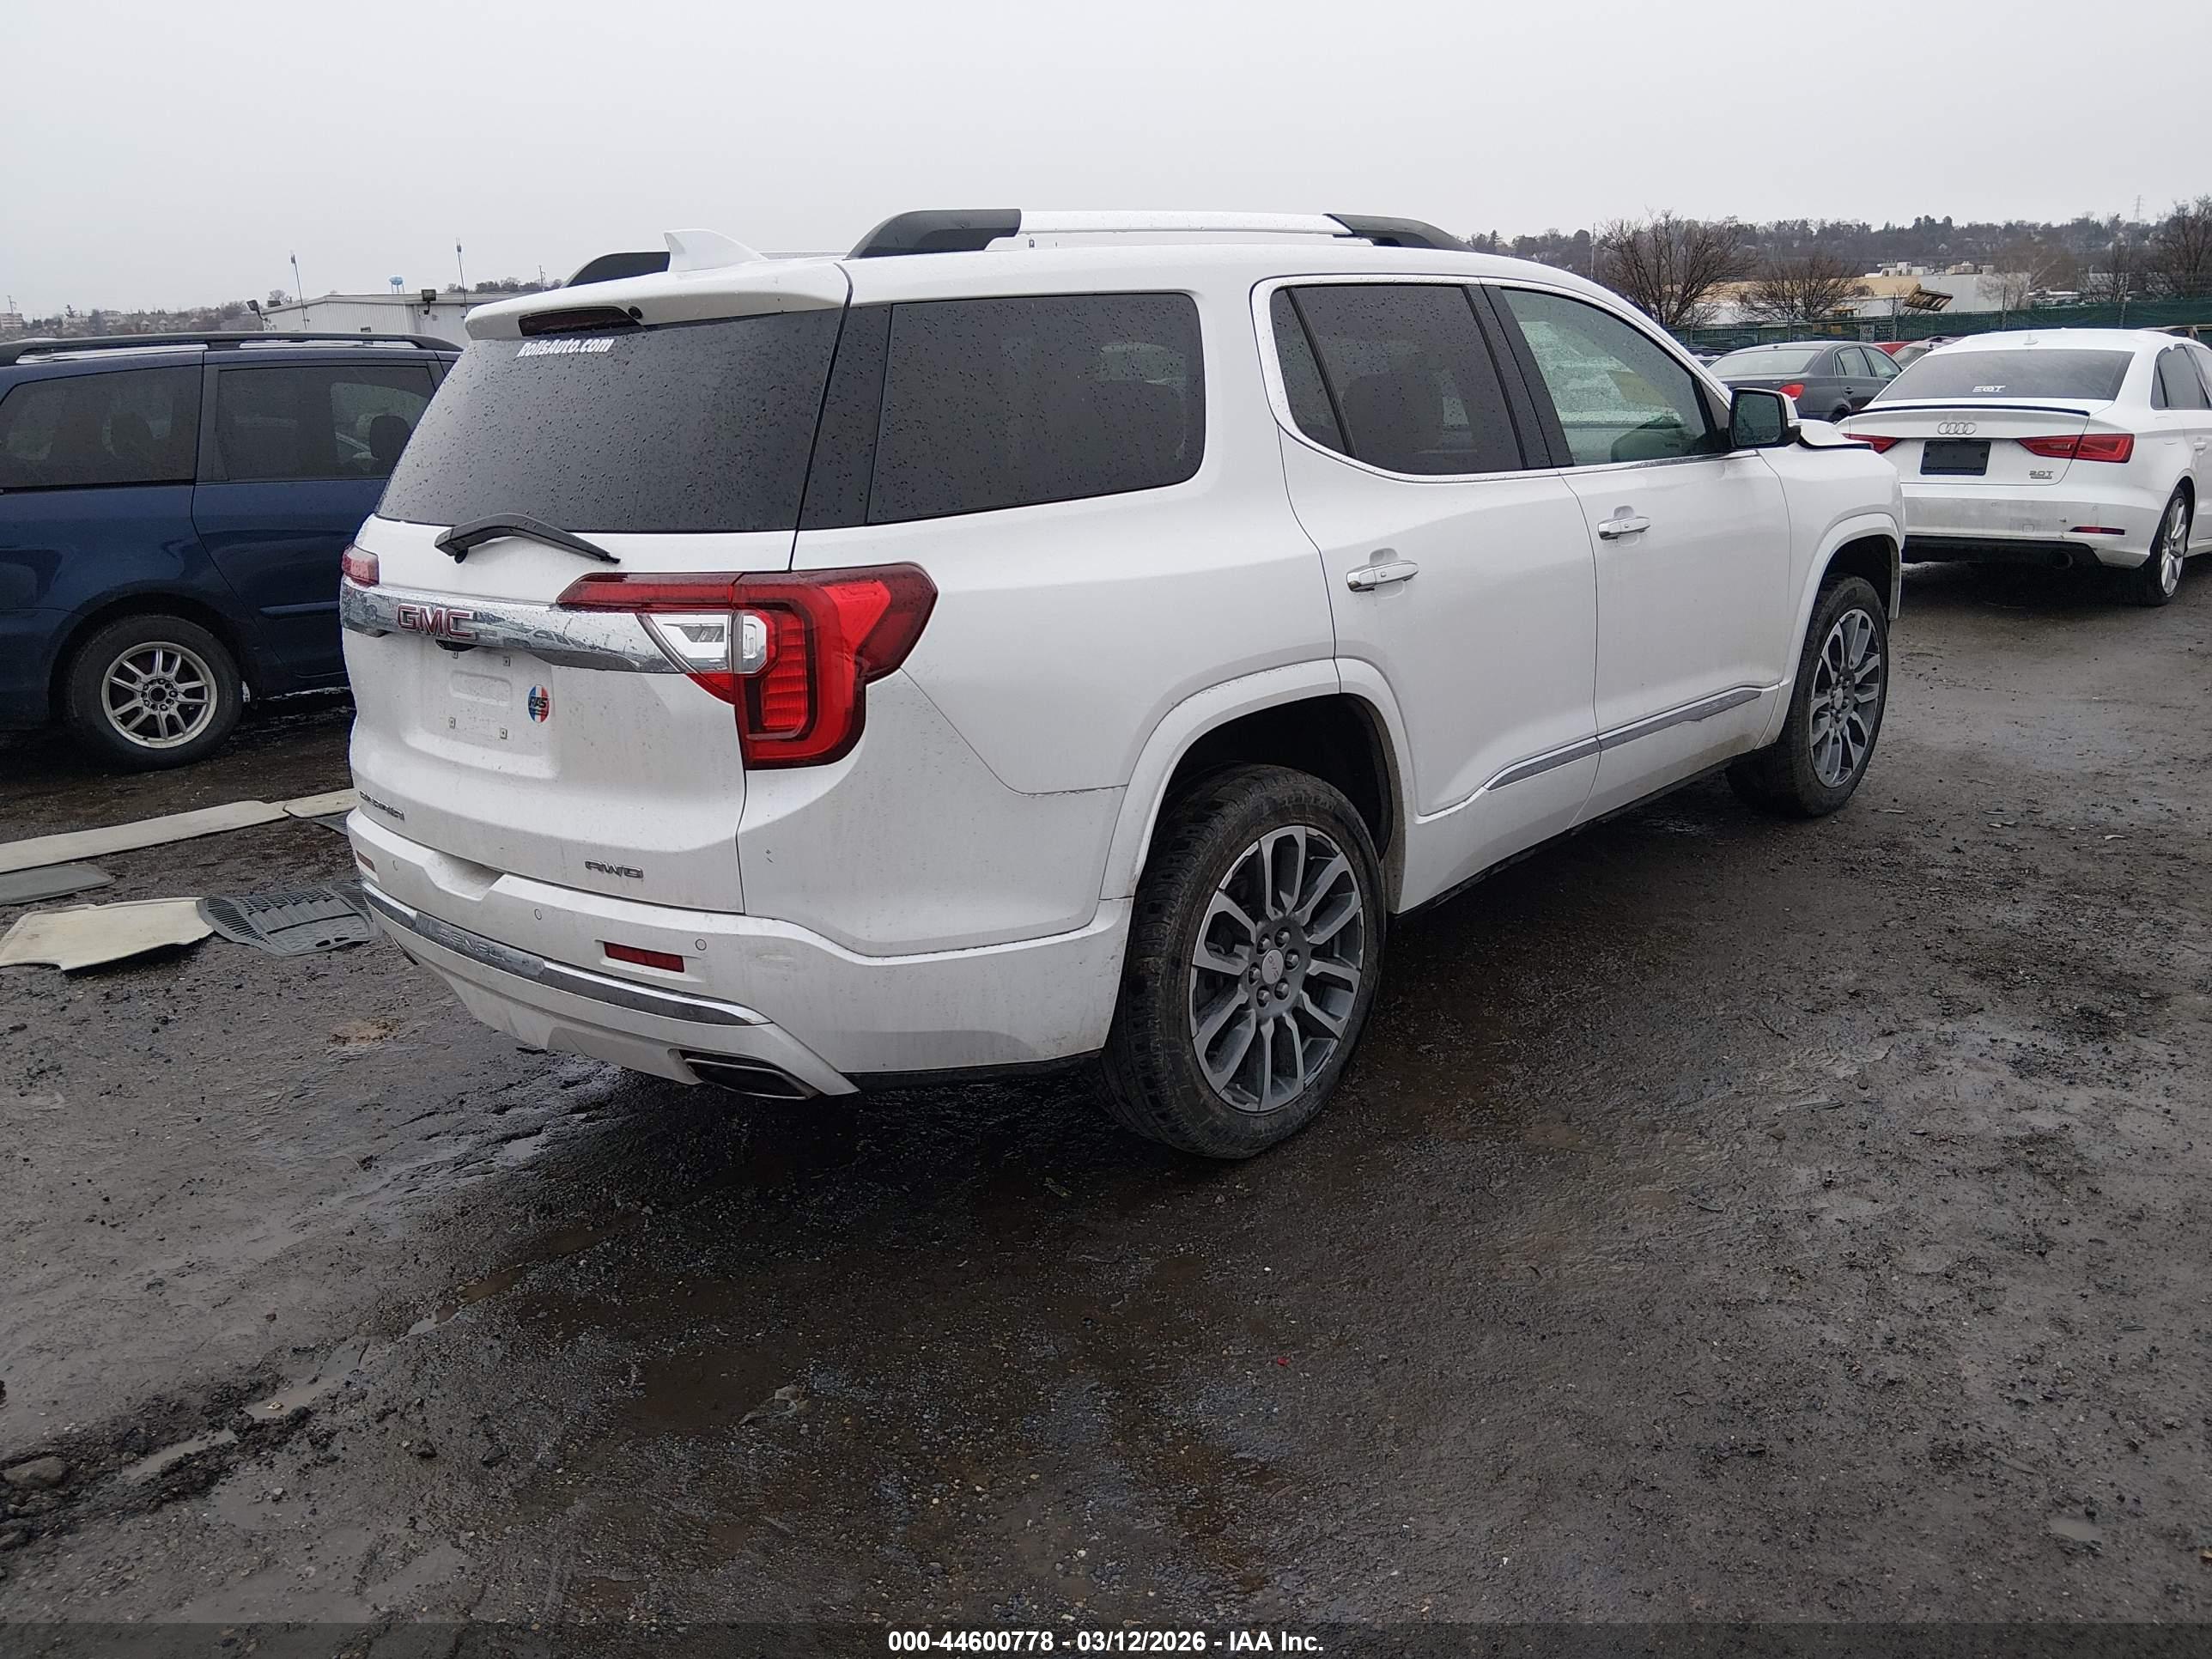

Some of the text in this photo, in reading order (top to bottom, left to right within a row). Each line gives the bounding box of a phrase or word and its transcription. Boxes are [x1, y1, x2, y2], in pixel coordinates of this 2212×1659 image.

[516, 337, 615, 357] RollsAuto.com
[397, 602, 477, 641] GMC
[584, 859, 644, 879] AWD
